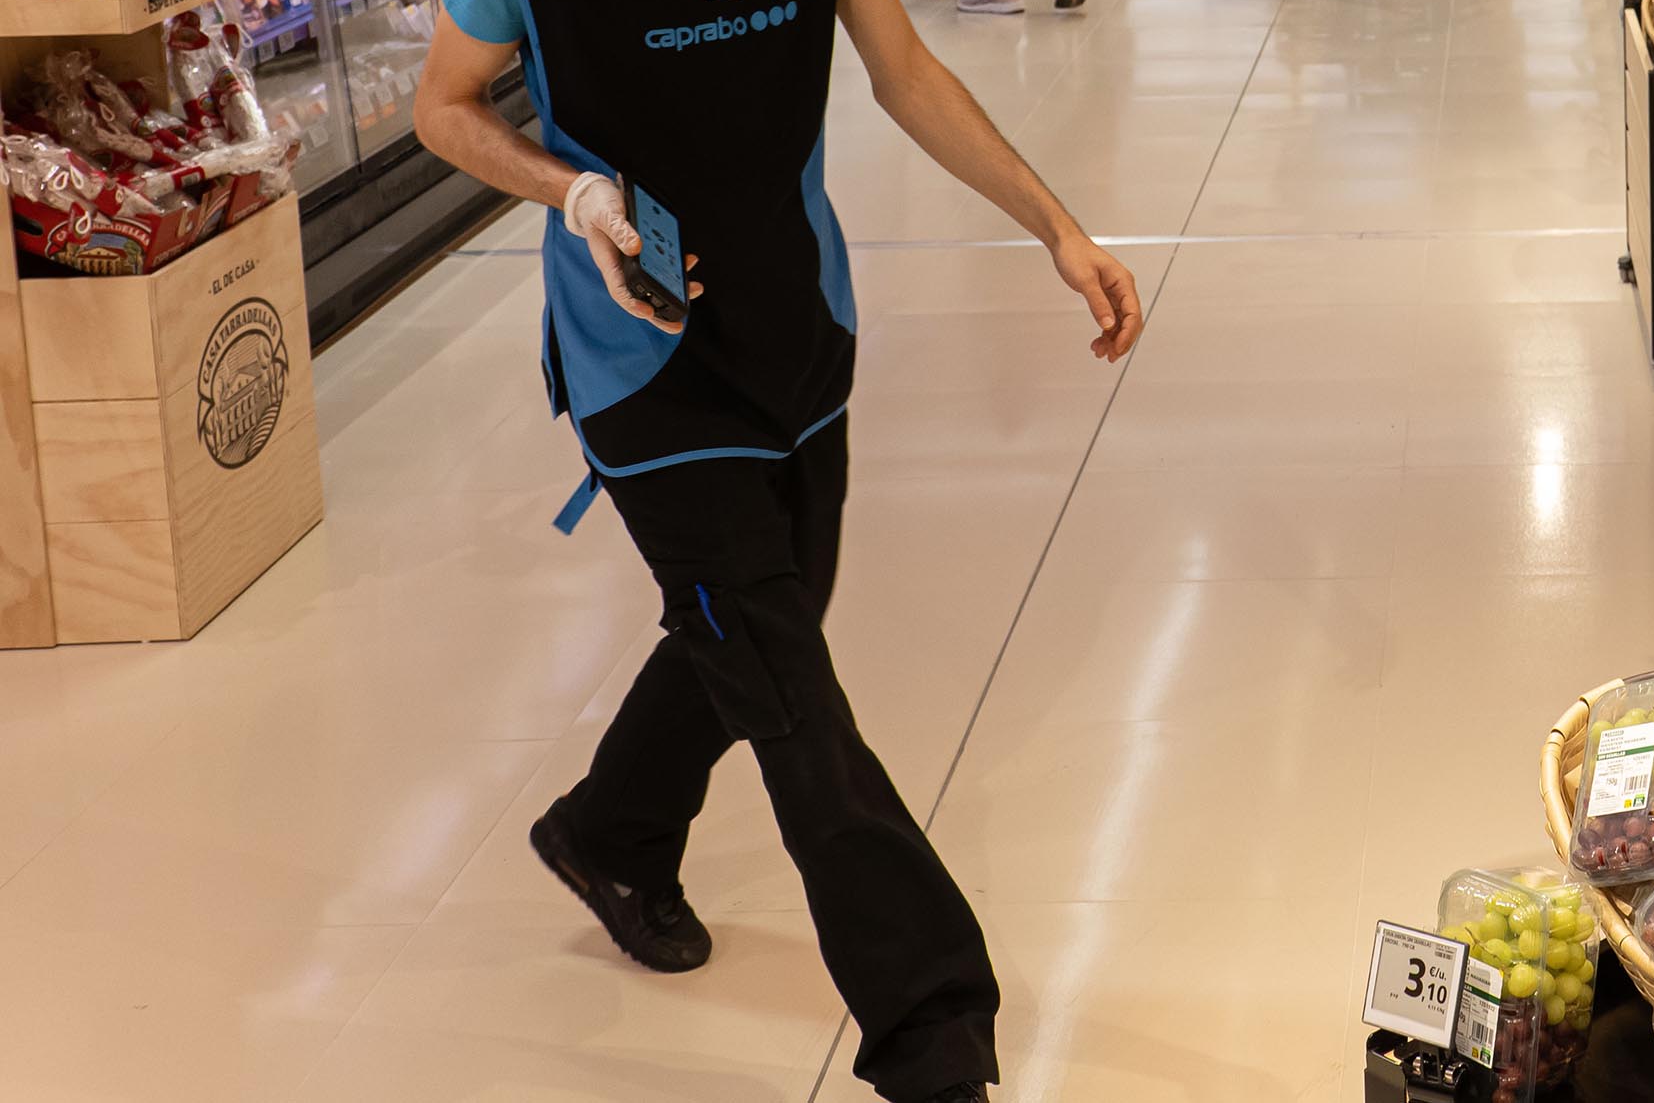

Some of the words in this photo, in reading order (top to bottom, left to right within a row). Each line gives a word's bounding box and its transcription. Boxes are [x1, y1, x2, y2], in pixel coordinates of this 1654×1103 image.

[644, 16, 748, 51] caprabo
[212, 280, 222, 296] EL
[223, 271, 234, 286] DE
[234, 260, 256, 281] CASA
[203, 339, 220, 384] CASA
[217, 309, 278, 347] TARRADELLAS
[1404, 958, 1447, 1004] 3,10
